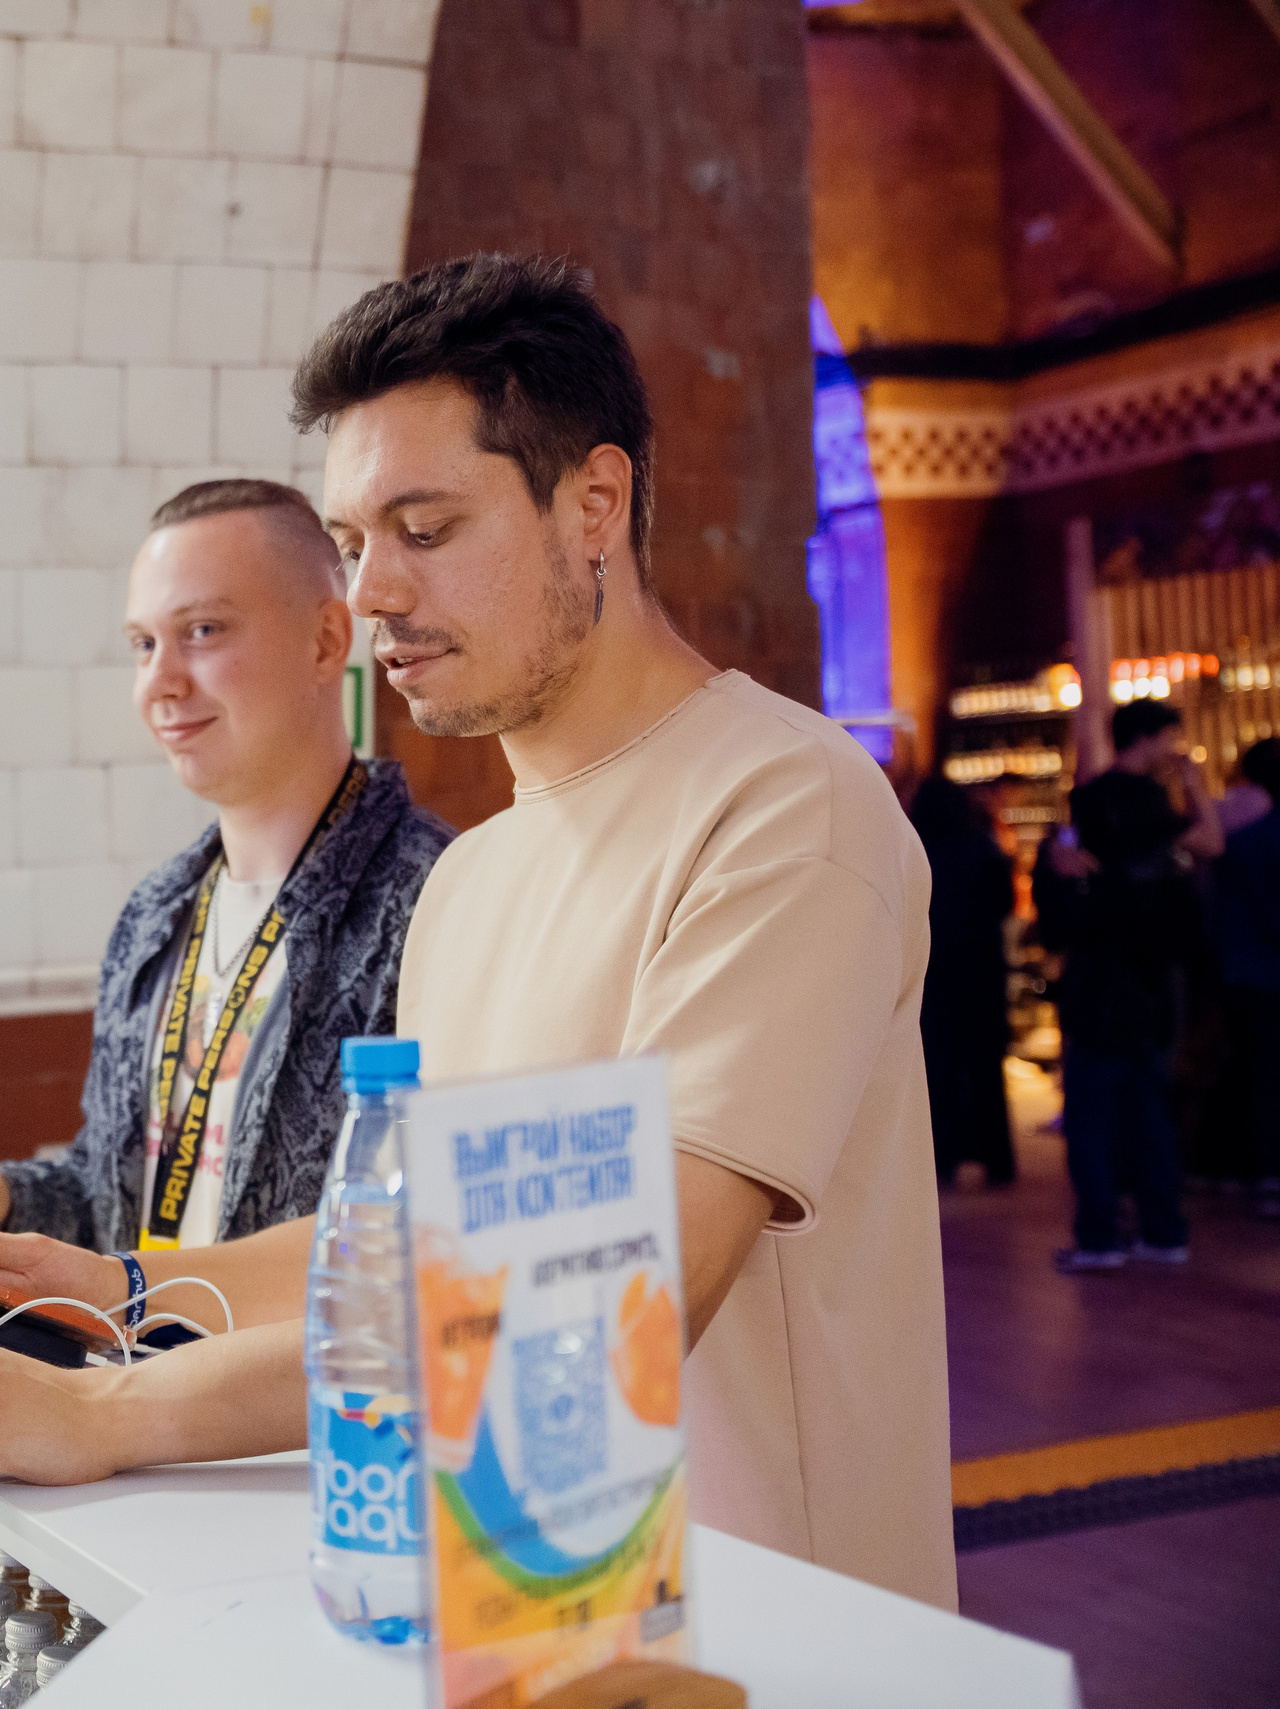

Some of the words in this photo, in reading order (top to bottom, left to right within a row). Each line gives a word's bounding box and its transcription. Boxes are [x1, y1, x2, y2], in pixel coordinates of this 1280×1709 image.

[163, 937, 202, 1053] PRIVATE
[159, 1094, 206, 1221] PRIVATE
[197, 945, 269, 1090] PERSONS
[326, 1499, 422, 1550] aqu
